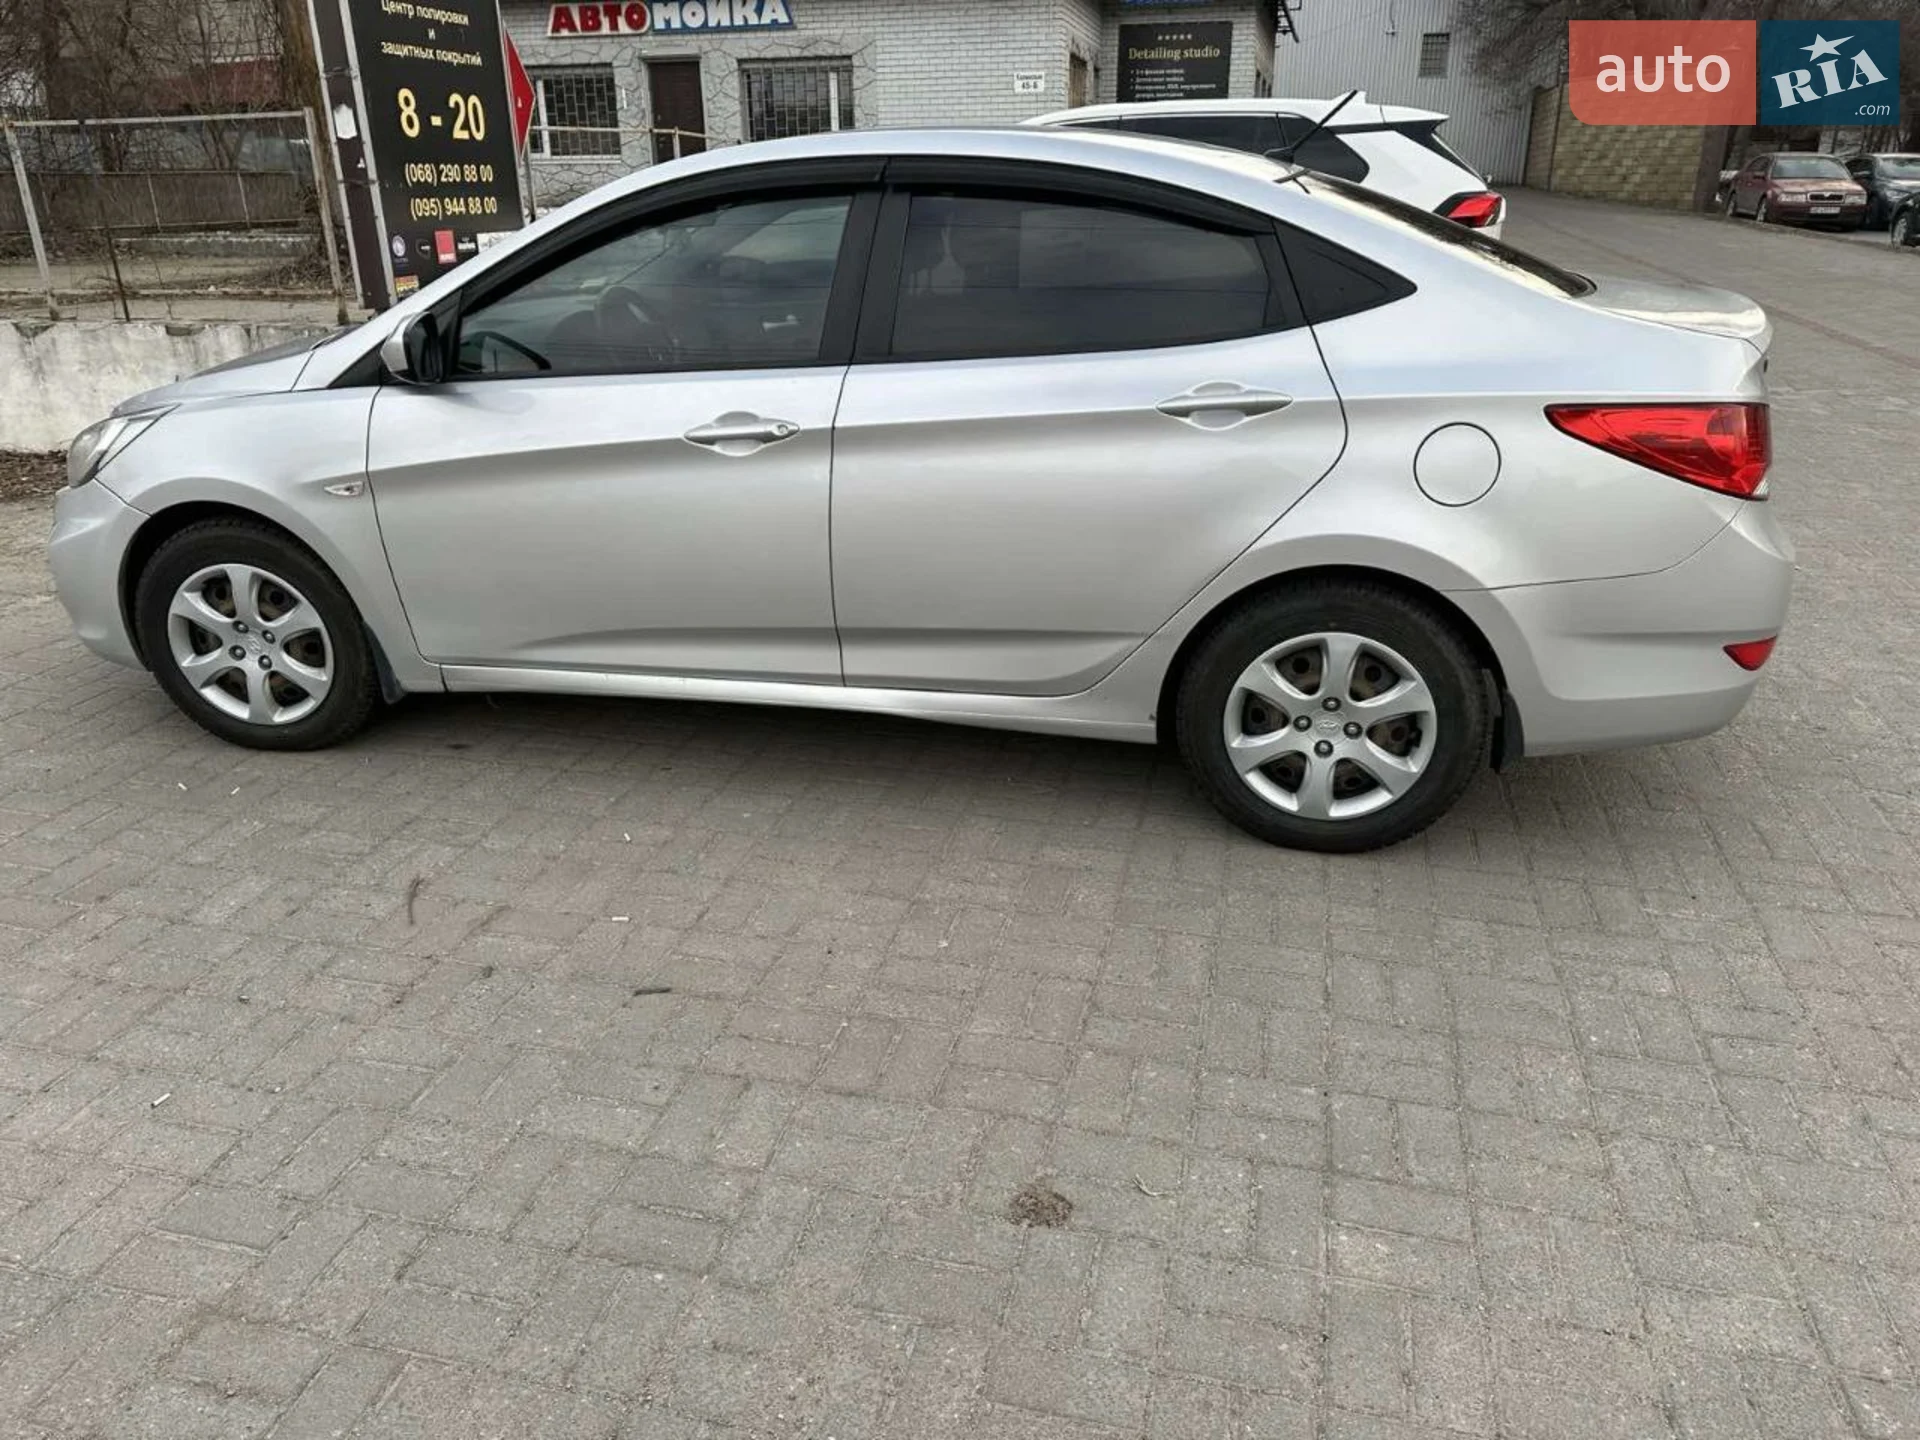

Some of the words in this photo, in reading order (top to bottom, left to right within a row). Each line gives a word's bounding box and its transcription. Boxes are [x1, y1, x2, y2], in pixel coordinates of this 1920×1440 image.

[381, 0, 415, 19] Центр
[416, 5, 469, 25] полировки
[427, 27, 436, 40] и
[381, 41, 435, 59] защитных
[436, 50, 483, 66] покрытий
[1128, 47, 1181, 61] Detailing
[1182, 45, 1220, 59] studio
[398, 87, 420, 138] 8
[448, 92, 485, 141] 20
[405, 163, 438, 187] (068)
[439, 164, 461, 182] 290
[463, 164, 478, 182] 88
[479, 164, 494, 182] 00
[410, 197, 442, 221] (095)
[444, 197, 466, 216] 944
[467, 196, 482, 214] 88
[484, 196, 497, 214] 00
